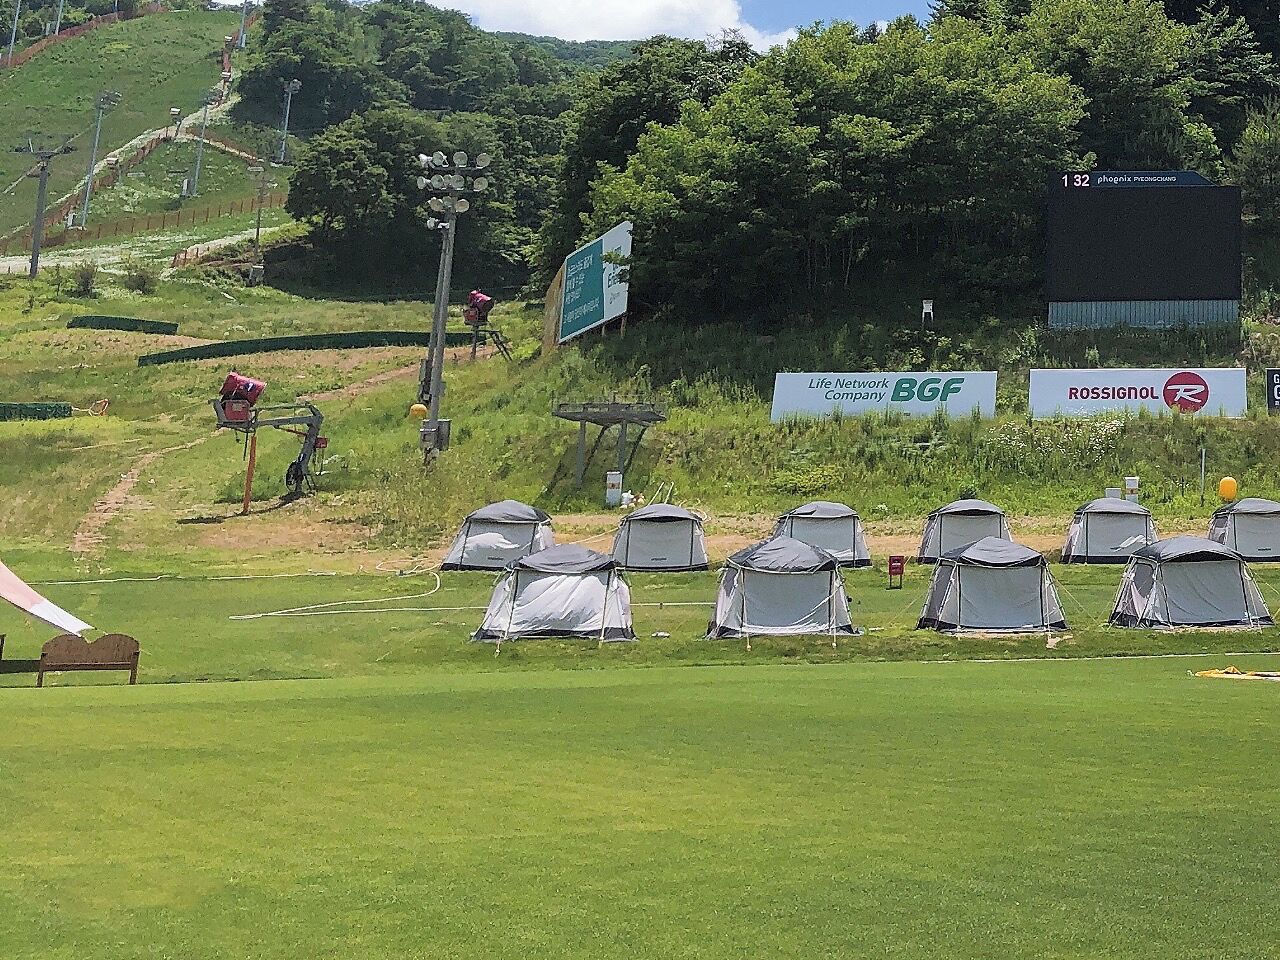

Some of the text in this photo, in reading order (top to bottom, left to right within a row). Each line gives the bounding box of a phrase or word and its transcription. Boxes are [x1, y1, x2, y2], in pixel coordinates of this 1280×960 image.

[1097, 174, 1132, 186] phoenix
[808, 378, 890, 389] Life Network
[890, 377, 965, 402] BGF
[824, 390, 886, 402] Company
[1068, 386, 1159, 400] ROSSIGNOL
